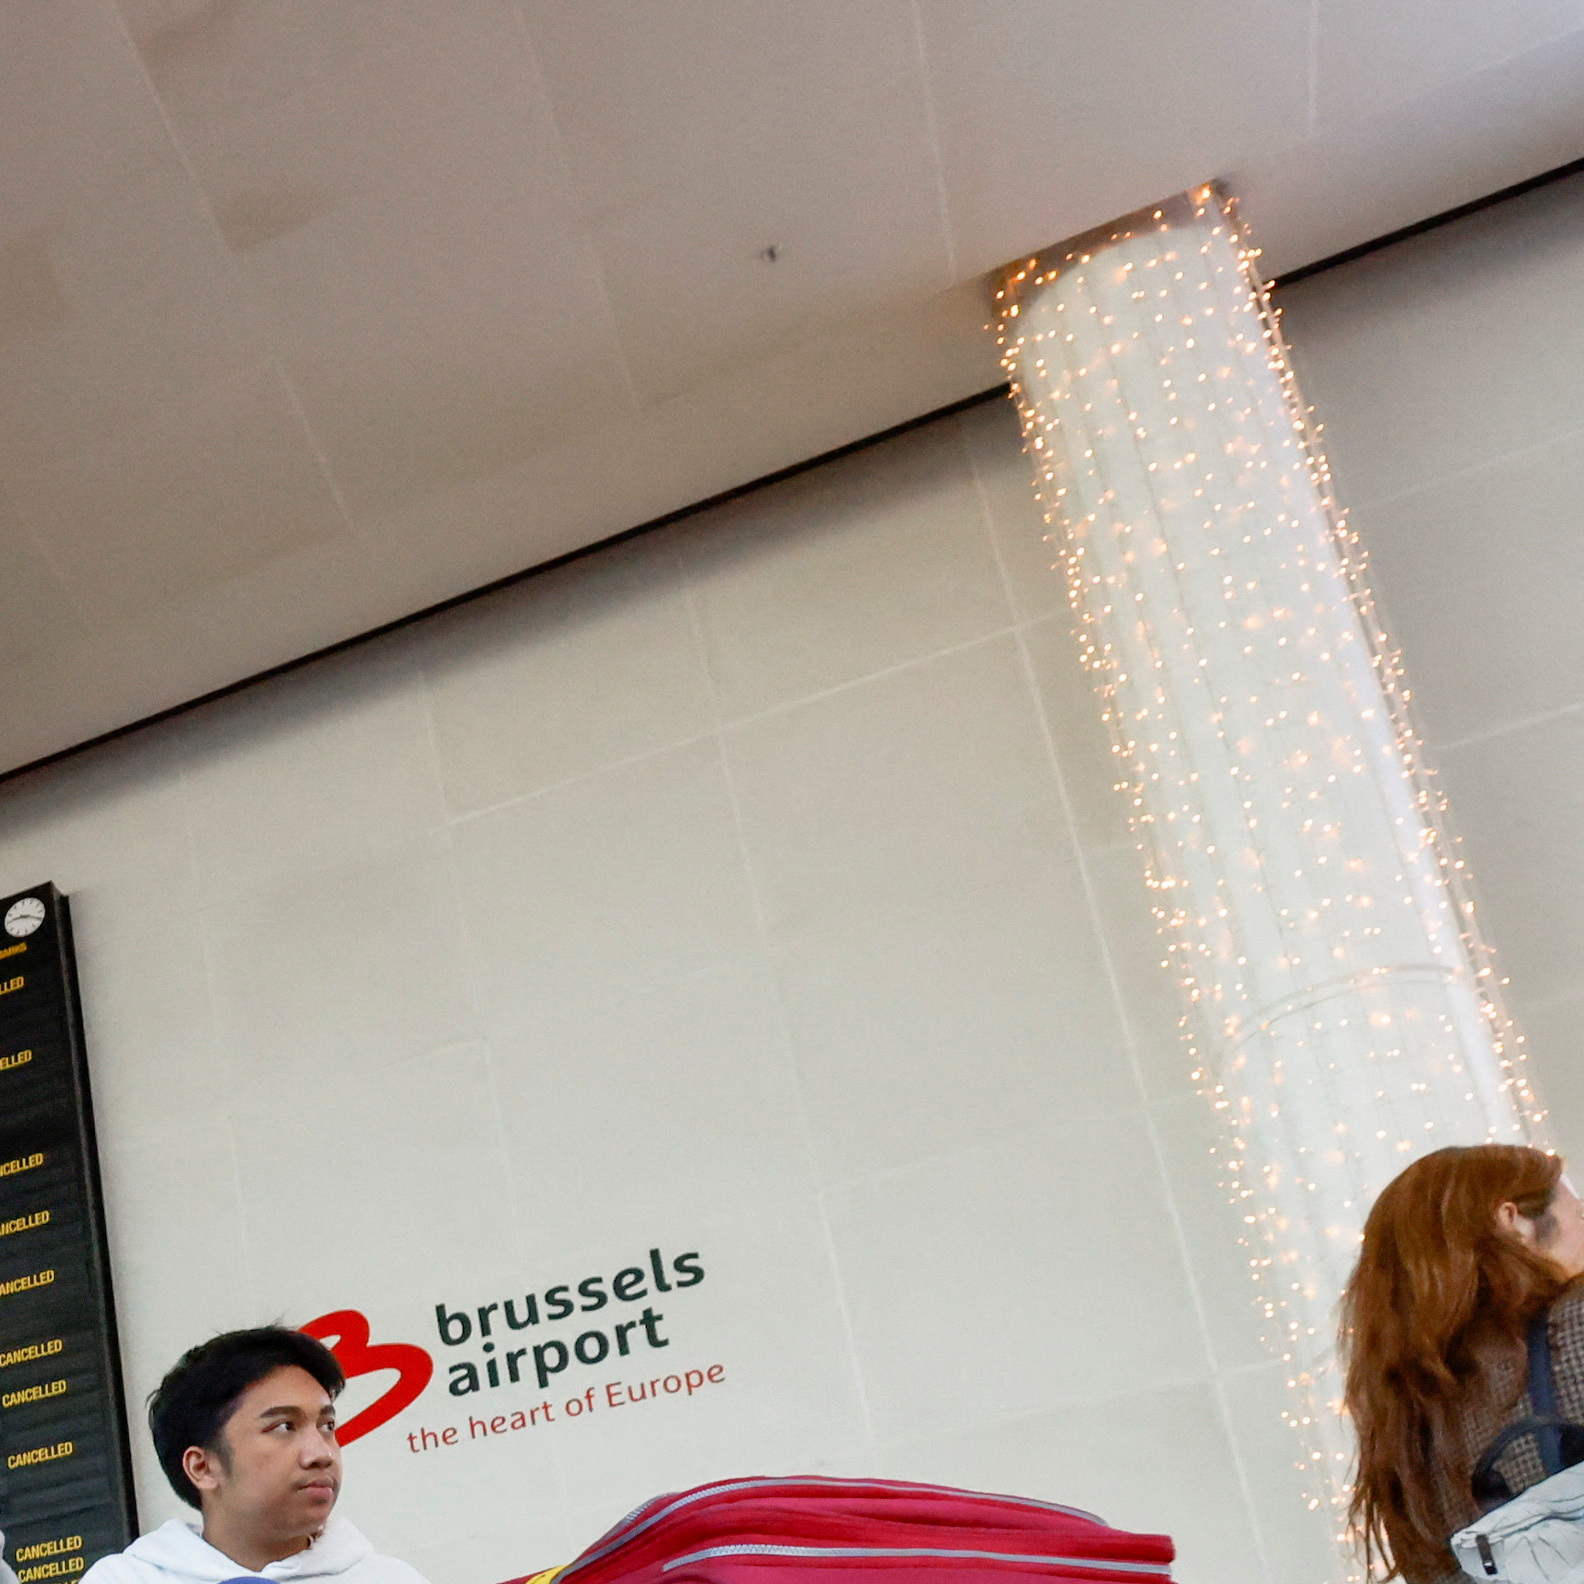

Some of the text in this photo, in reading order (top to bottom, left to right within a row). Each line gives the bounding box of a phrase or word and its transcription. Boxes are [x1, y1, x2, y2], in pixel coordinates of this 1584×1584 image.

[435, 1247, 706, 1347] brussels
[448, 1306, 670, 1398] airport
[2, 1380, 66, 1407] CANCELLED
[406, 1363, 727, 1454] the heart of Europe
[8, 1442, 72, 1468] CANCELLED
[16, 1535, 82, 1561] CANCELLED
[18, 1557, 84, 1583] CANCELLED
